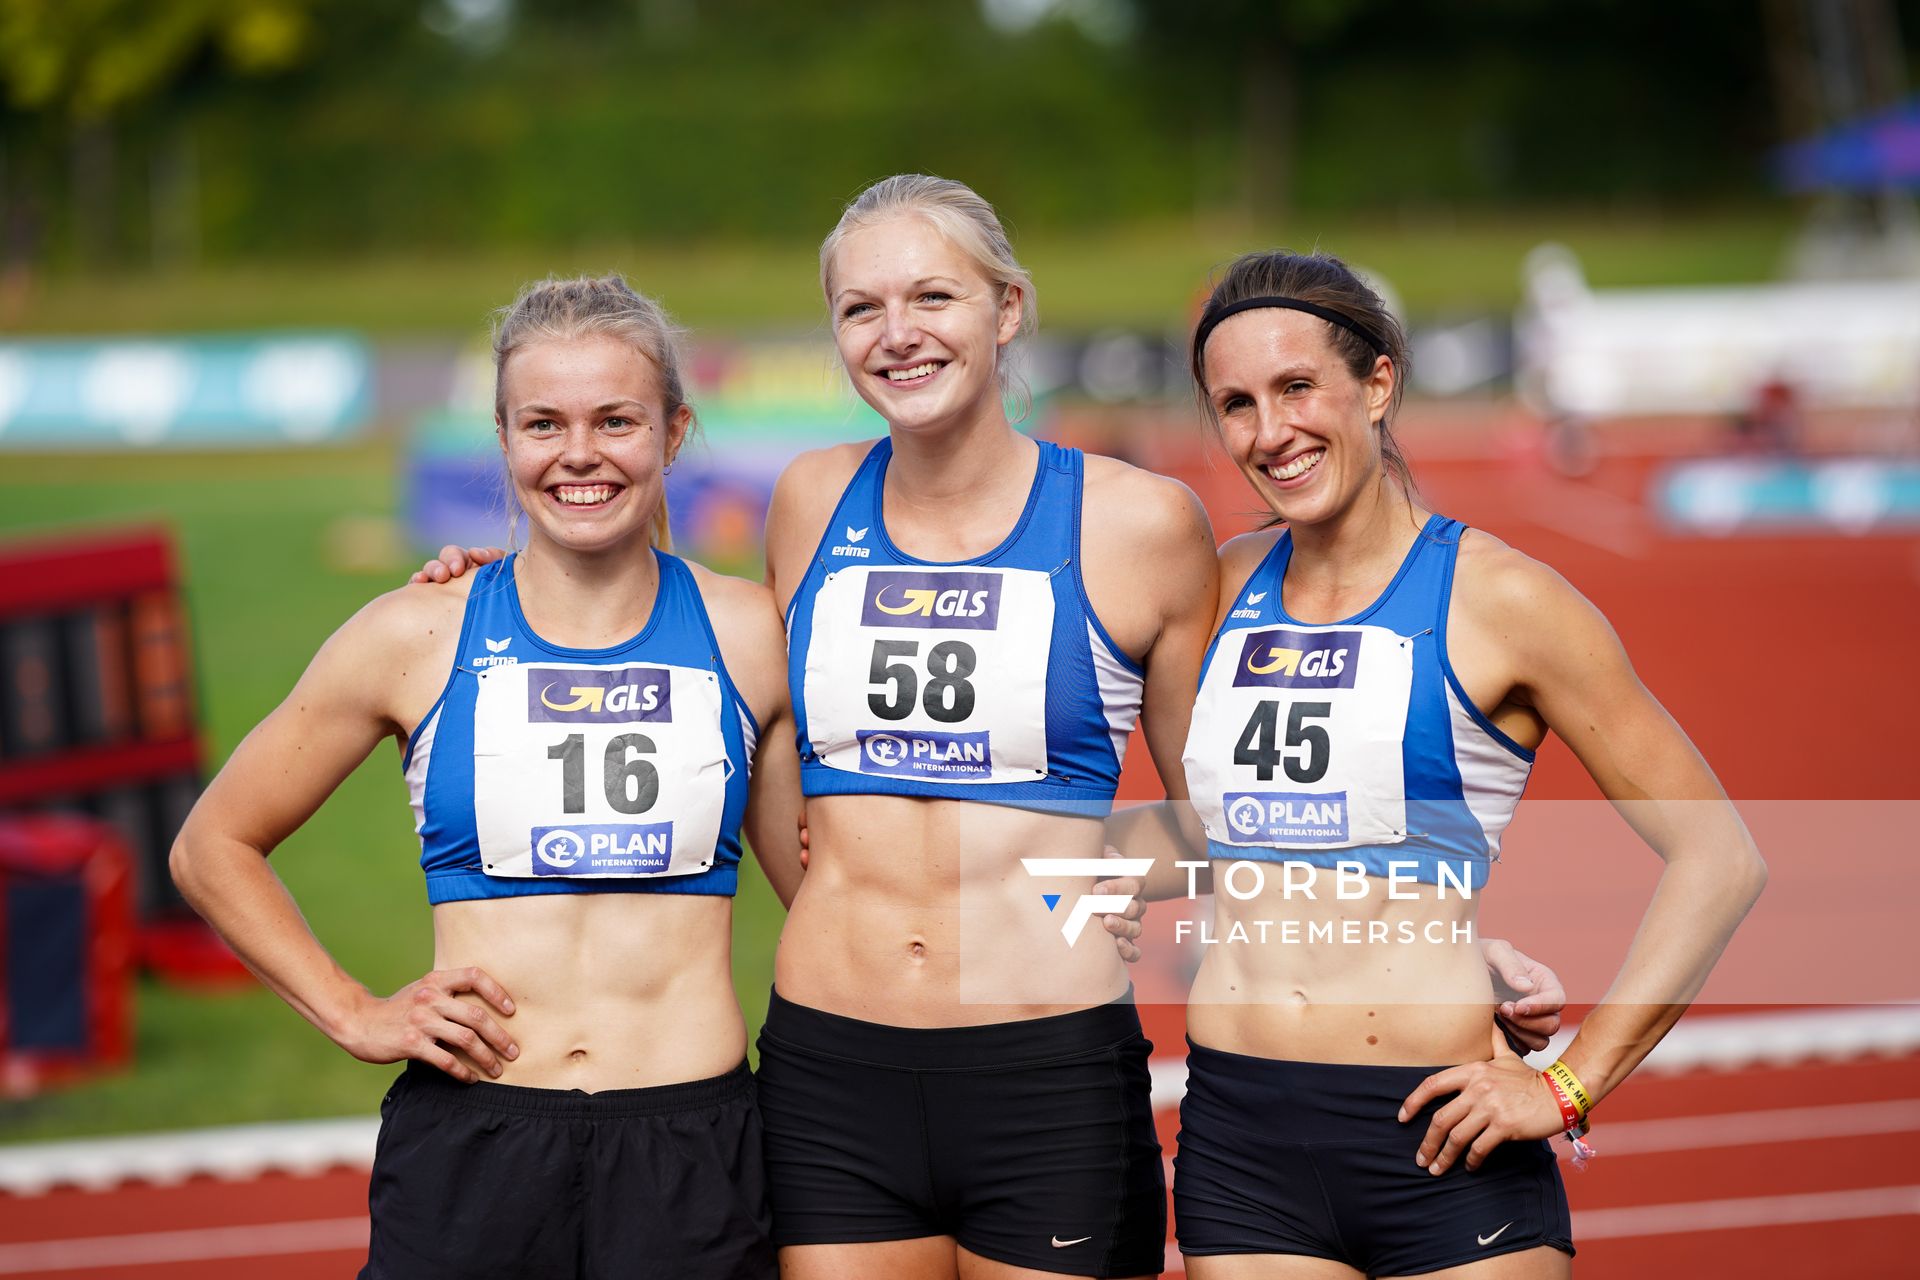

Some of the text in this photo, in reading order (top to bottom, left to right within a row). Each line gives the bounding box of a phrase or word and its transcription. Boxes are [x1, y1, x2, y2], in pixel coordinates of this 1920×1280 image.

[832, 545, 870, 558] erima
[936, 590, 988, 617] GLS
[1231, 608, 1260, 620] erima
[473, 655, 518, 667] erima
[1300, 649, 1348, 678] GLS
[867, 639, 976, 723] 58
[605, 684, 658, 713] GLS
[913, 740, 983, 762] PLAN
[1233, 700, 1331, 783] 45
[548, 733, 659, 814] 16
[913, 762, 985, 772] INTERNATIONAL
[1269, 801, 1341, 825] PLAN
[1269, 827, 1342, 836] INTERNATIONAL
[591, 833, 666, 855] PLAN
[591, 858, 664, 867] INTERNATIONAL
